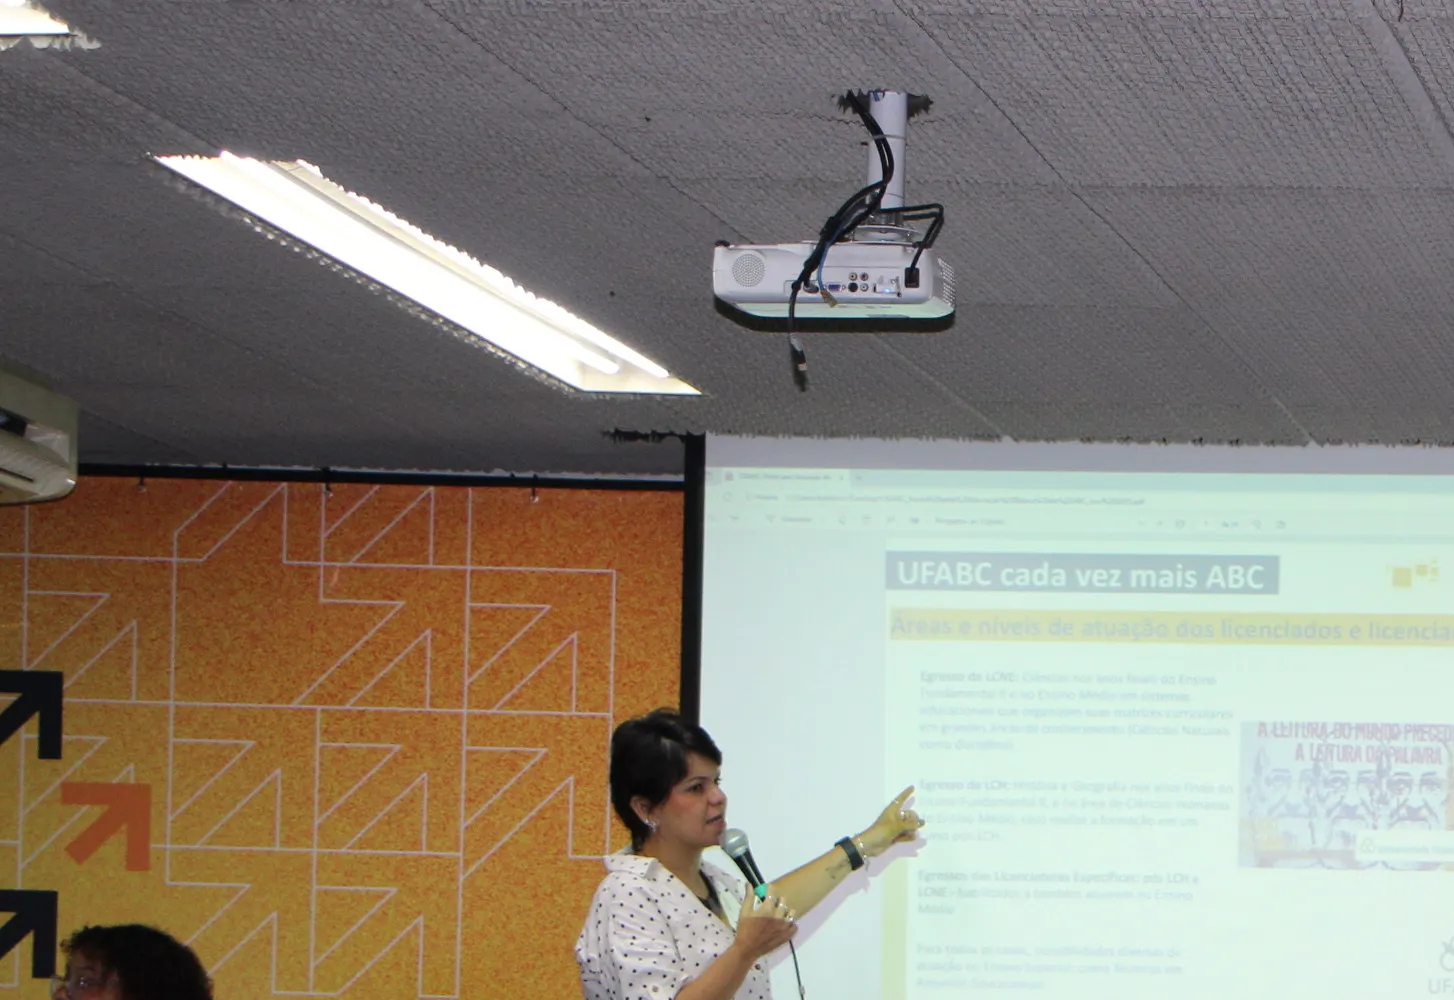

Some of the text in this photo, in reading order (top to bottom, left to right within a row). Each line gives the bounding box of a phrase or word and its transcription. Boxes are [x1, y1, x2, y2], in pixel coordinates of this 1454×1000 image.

[897, 559, 1265, 590] UFABC cada vez mais ABC
[891, 612, 952, 636] Áreas
[958, 620, 971, 636] e
[978, 615, 1040, 637] níveis
[1048, 617, 1074, 637] de
[1082, 617, 1168, 643] atuação
[1175, 618, 1214, 639] dos
[1221, 619, 1342, 641] licenciados
[1348, 625, 1361, 641] e
[1258, 722, 1268, 738] A
[1310, 744, 1362, 763] LEITURA
